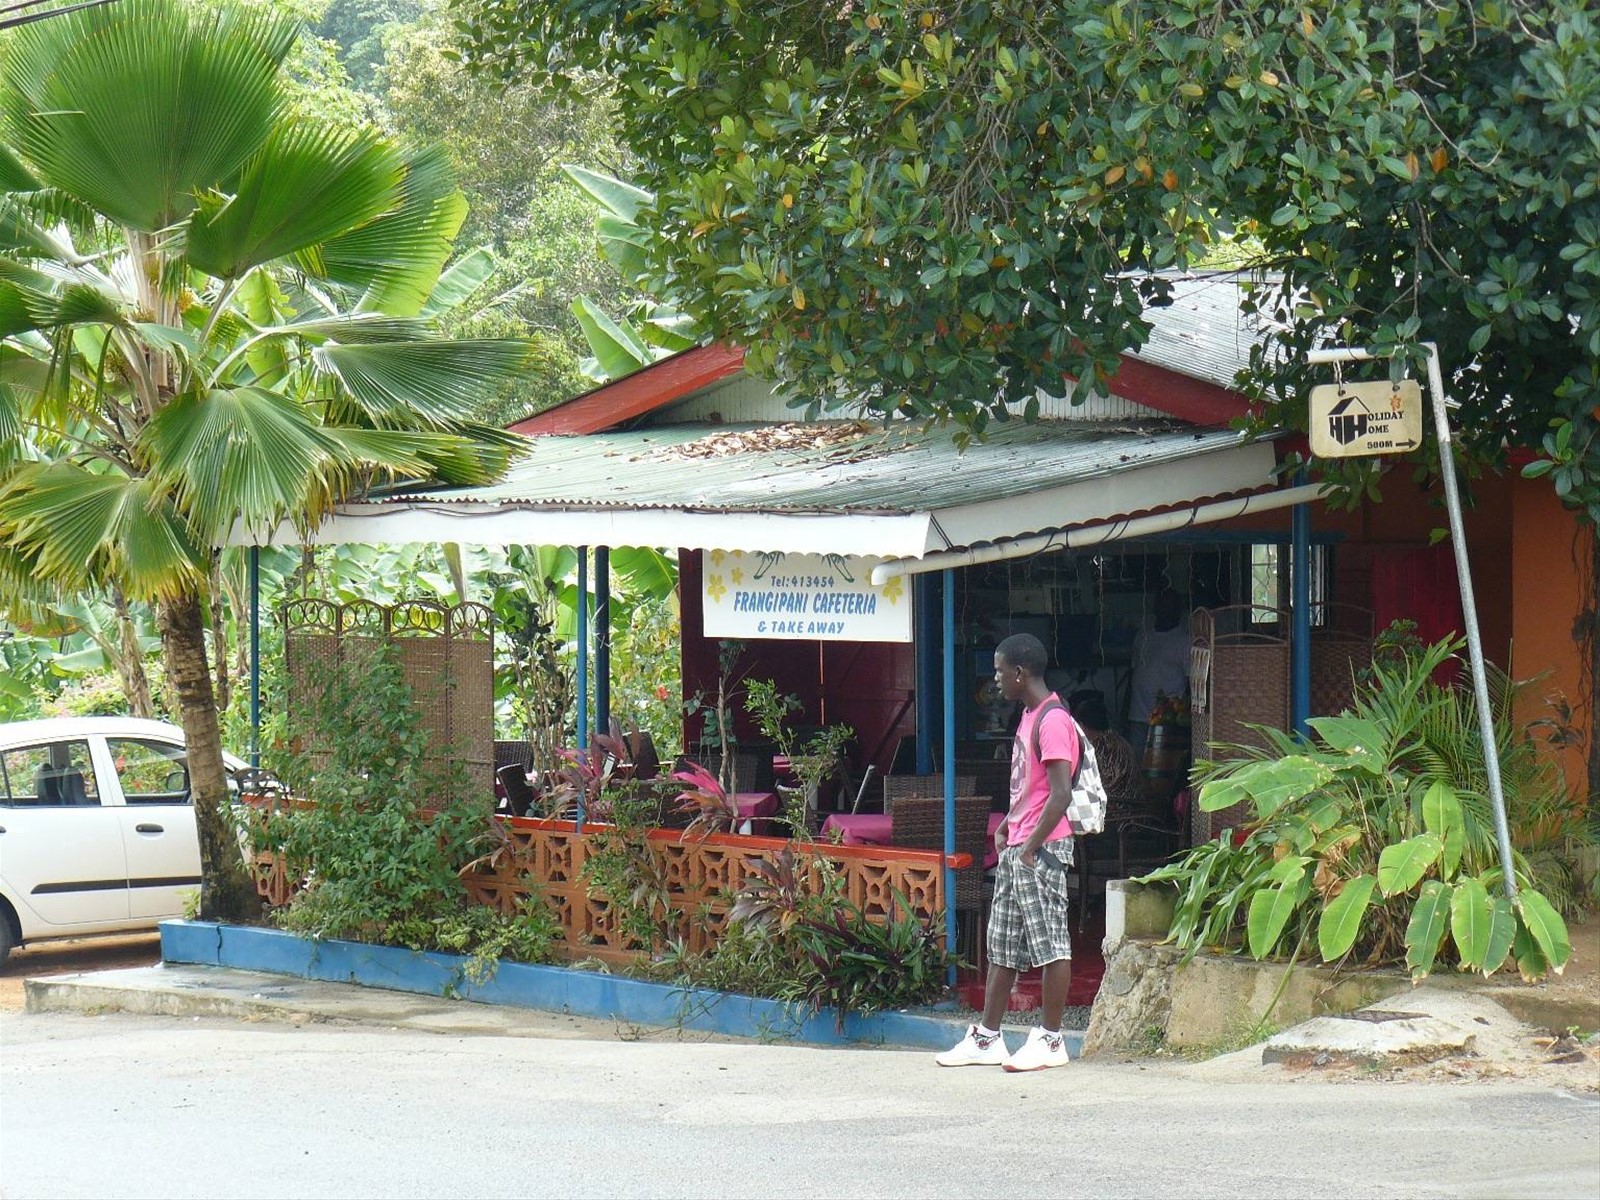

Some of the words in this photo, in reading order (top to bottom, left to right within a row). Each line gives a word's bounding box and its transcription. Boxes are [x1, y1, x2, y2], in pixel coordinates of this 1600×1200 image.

[1367, 440, 1393, 449] 500M
[733, 591, 809, 614] FRANGIPANI
[812, 592, 877, 615] CAFETERIA
[757, 620, 767, 633] &
[772, 621, 804, 634] TAKE
[807, 621, 845, 634] AWAY
